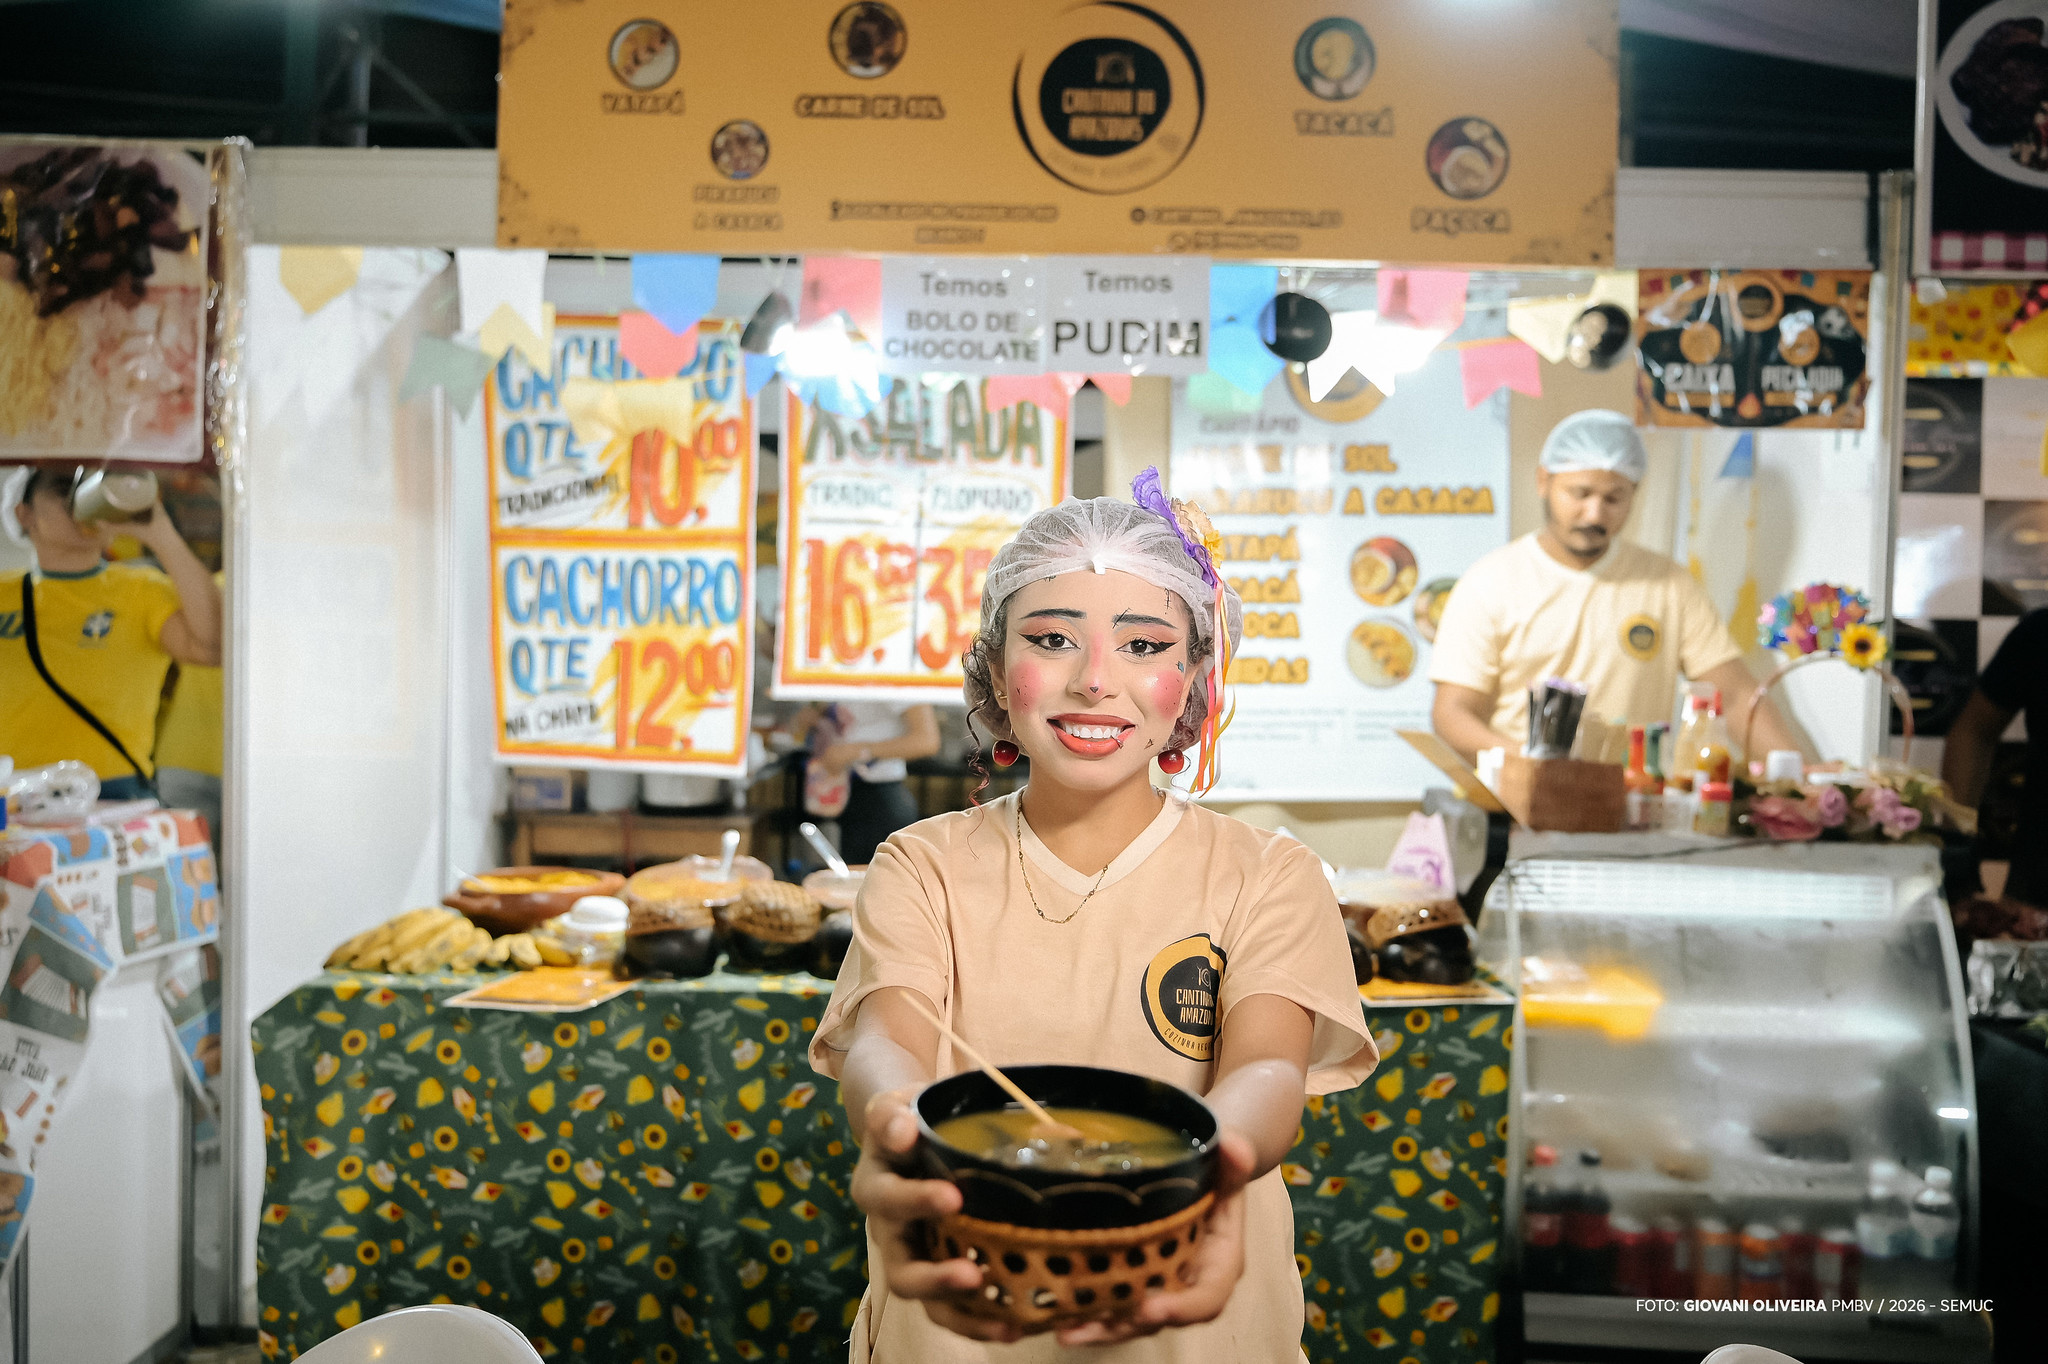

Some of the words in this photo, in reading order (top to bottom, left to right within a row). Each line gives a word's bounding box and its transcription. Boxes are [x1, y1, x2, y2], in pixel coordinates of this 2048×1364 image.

[1293, 106, 1395, 137] TACACÁ
[920, 274, 1008, 297] Temos
[1084, 271, 1173, 294] Temos
[906, 311, 977, 333] BOLO
[985, 313, 1020, 333] DE
[885, 339, 1040, 362] CHOCOLATE
[1054, 321, 1199, 356] PUDIM
[1343, 444, 1397, 473] SOL
[1343, 487, 1366, 515] A
[1374, 486, 1496, 515] CASACA
[506, 556, 742, 628] CACHORRO
[511, 638, 590, 697] QTE
[1164, 1028, 1195, 1050] COZINHA
